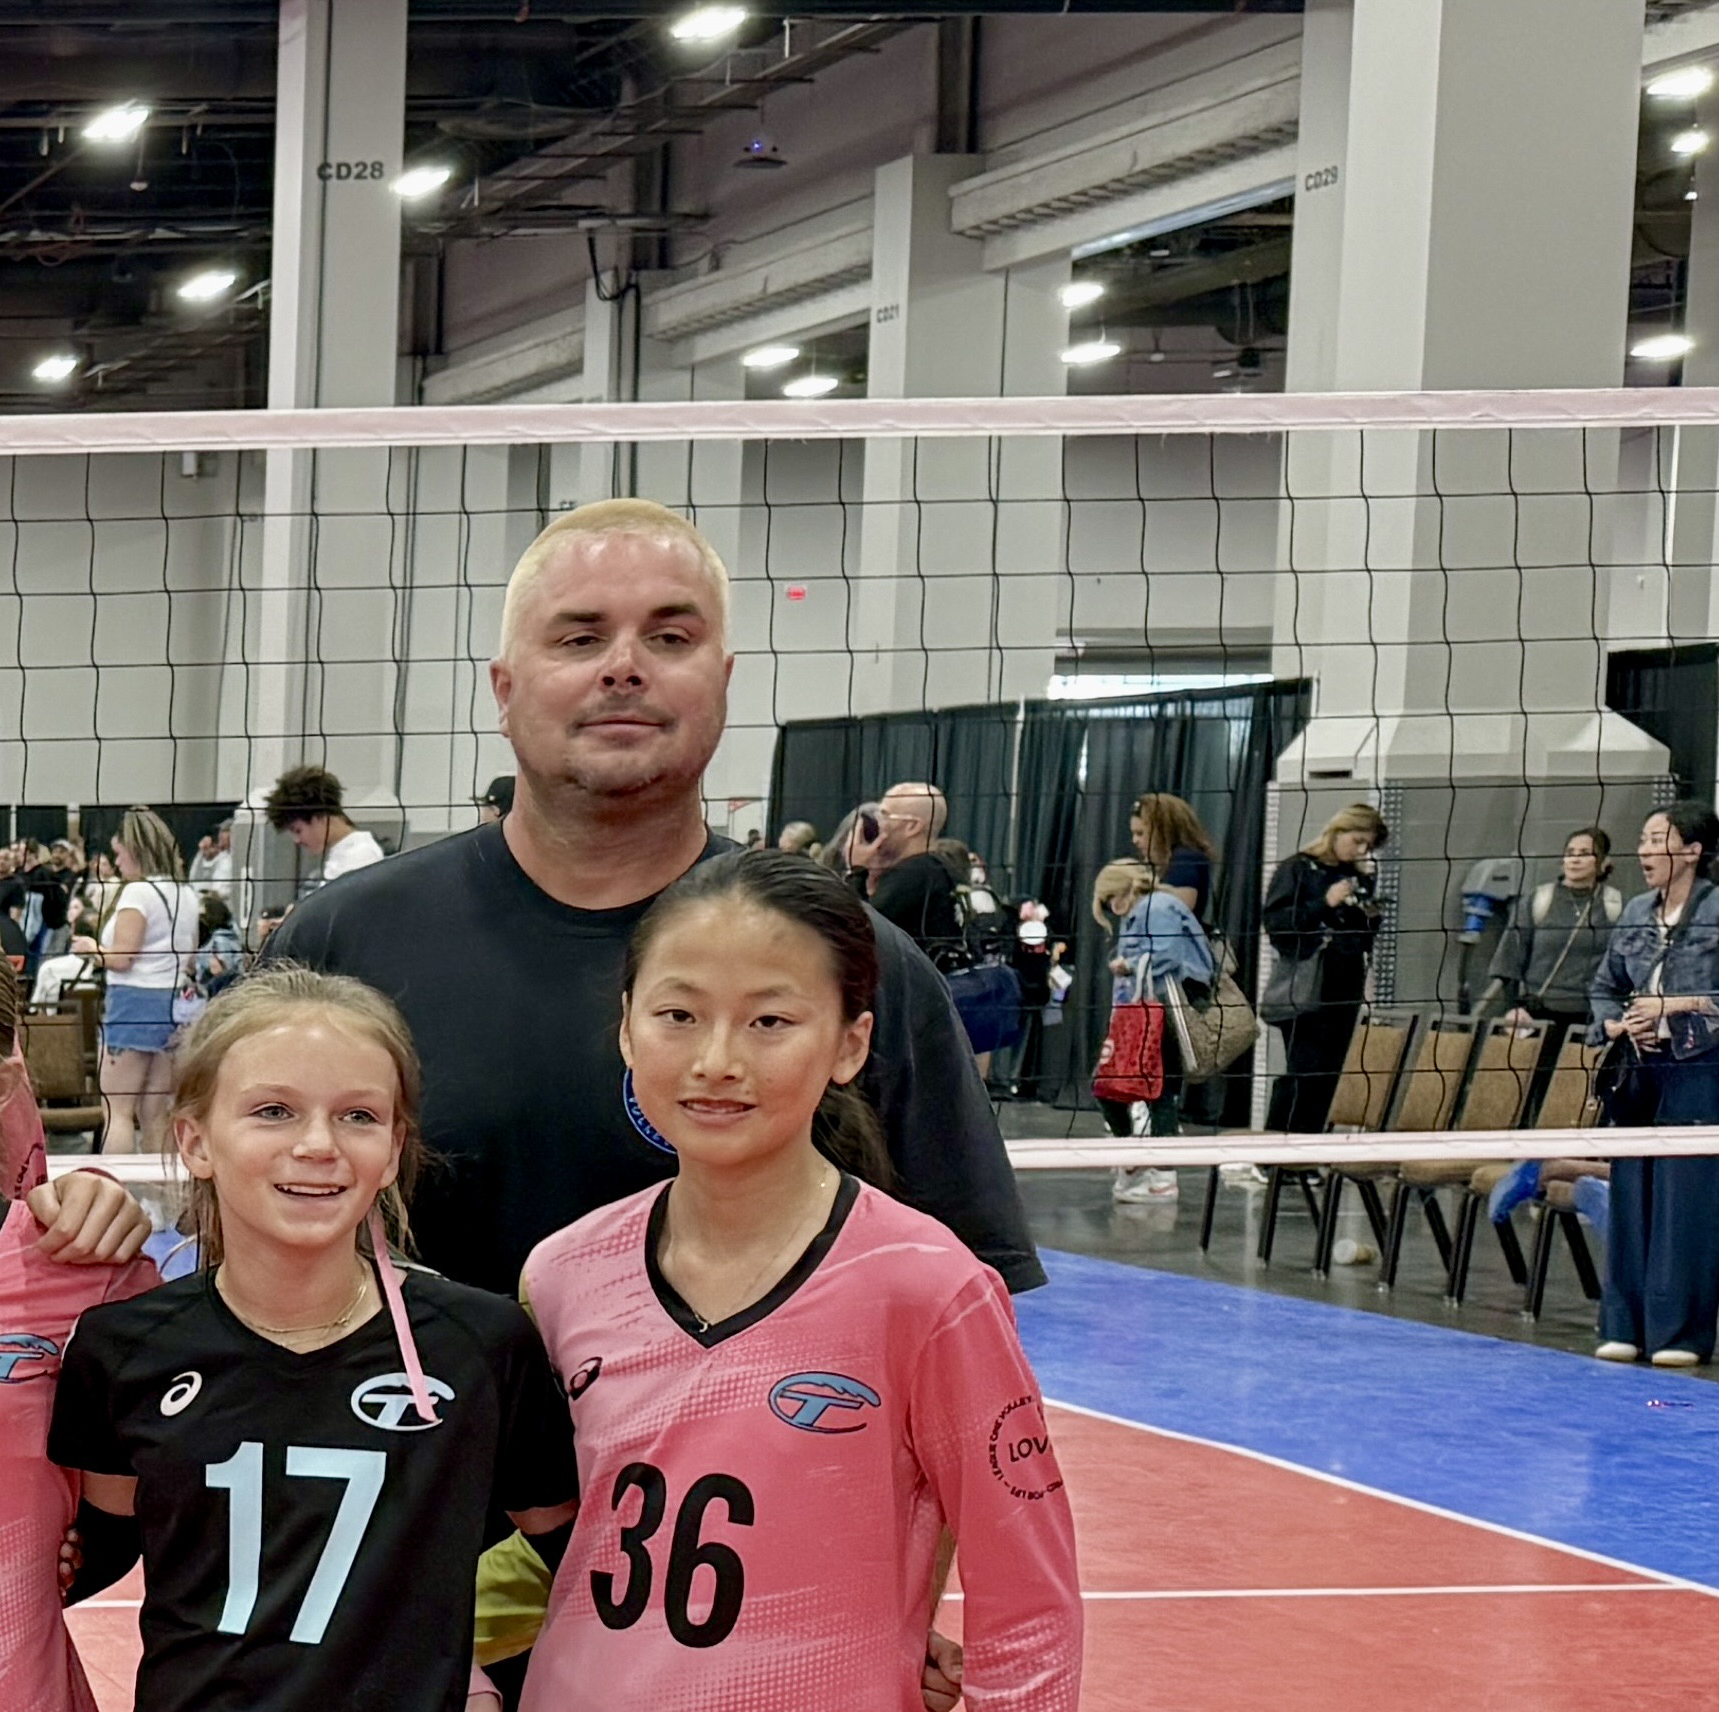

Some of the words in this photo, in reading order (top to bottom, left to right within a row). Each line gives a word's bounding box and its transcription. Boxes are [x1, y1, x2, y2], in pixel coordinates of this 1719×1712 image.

[316, 161, 384, 180] CD28
[1305, 165, 1338, 191] CD29
[205, 1441, 387, 1645] 17
[589, 1461, 755, 1649] 36
